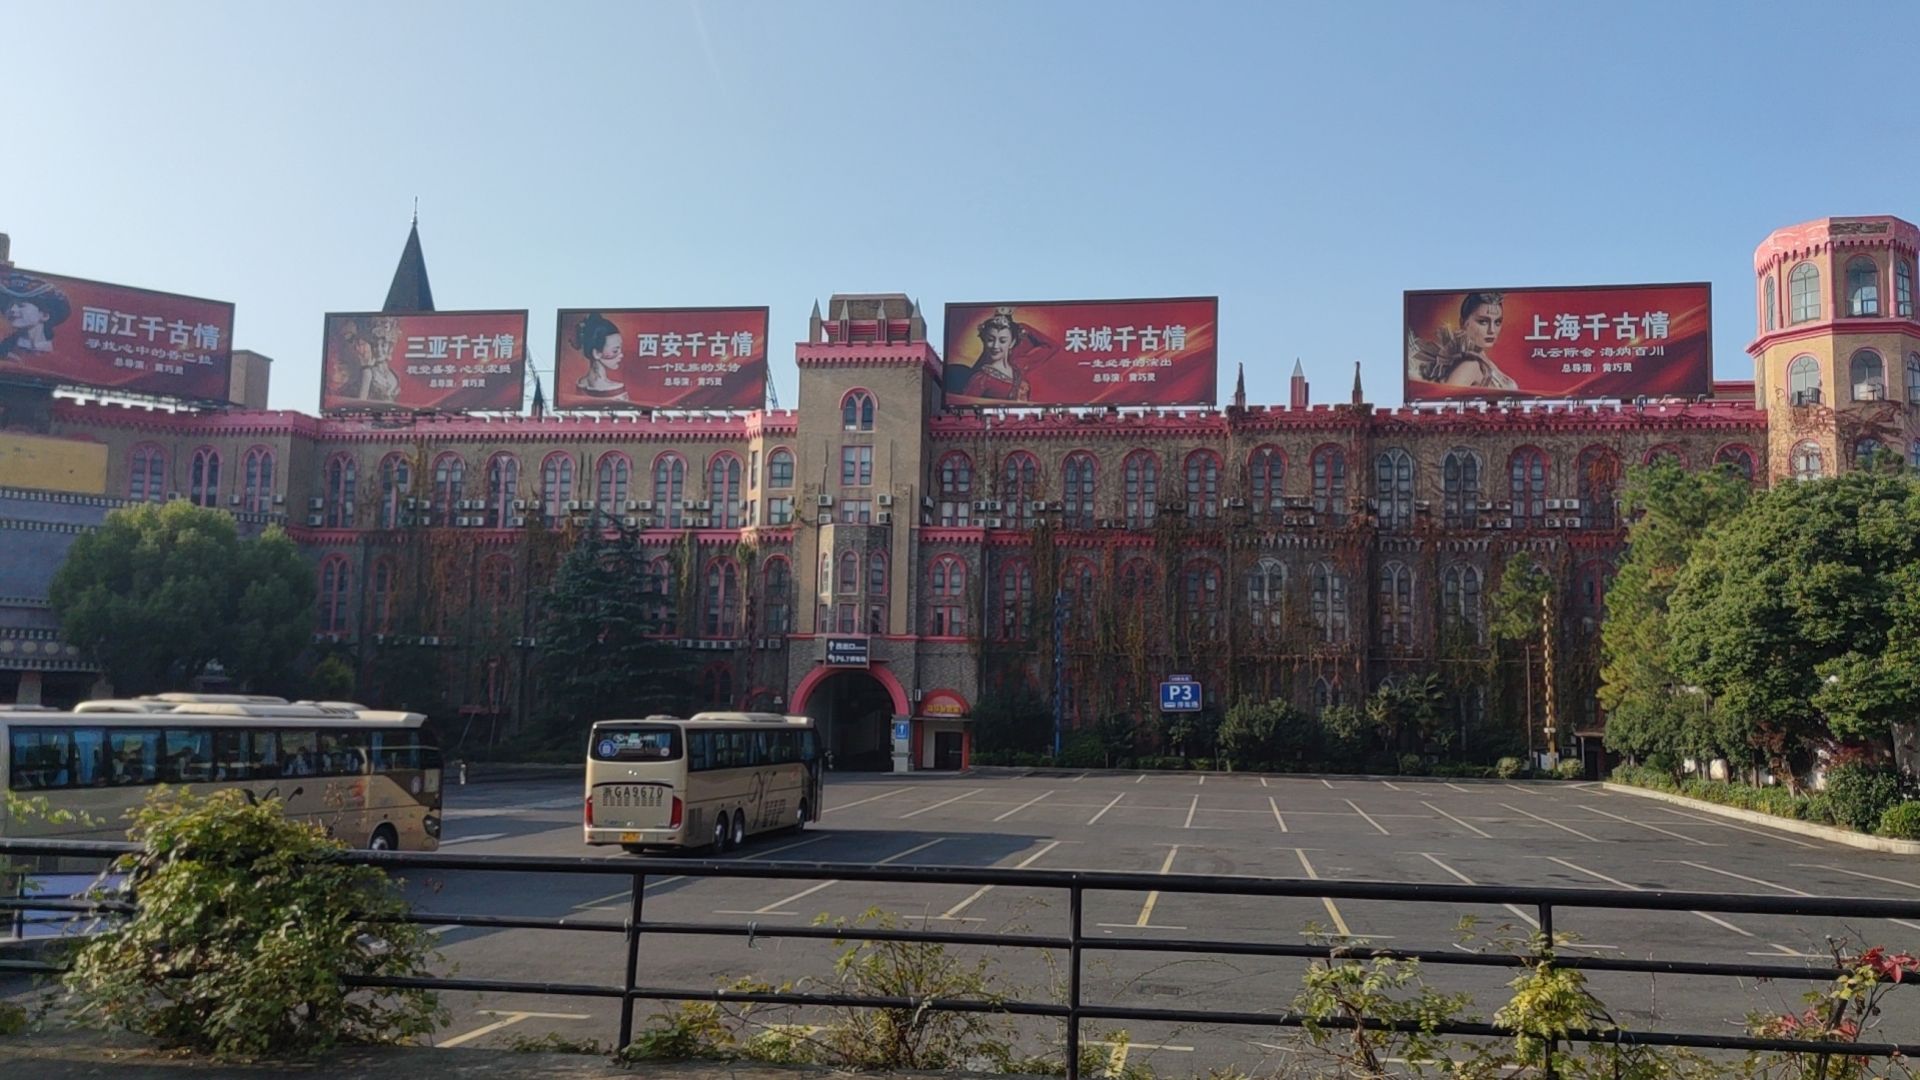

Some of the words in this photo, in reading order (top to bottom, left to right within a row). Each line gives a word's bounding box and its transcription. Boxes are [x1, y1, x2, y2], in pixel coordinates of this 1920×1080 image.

[82, 306, 220, 350] 丽江千古情
[1065, 324, 1186, 353] 宋城千古情
[1524, 311, 1671, 341] 上海千古情
[85, 338, 214, 365] 寻找心中的香巴拉
[404, 334, 514, 359] 三亚千古情
[638, 331, 753, 357] 西安千古情
[1531, 347, 1595, 358] 风云际会
[1600, 346, 1664, 357] 海纳百川
[1078, 358, 1172, 368] 一生必看的演出
[1169, 685, 1192, 701] P3
